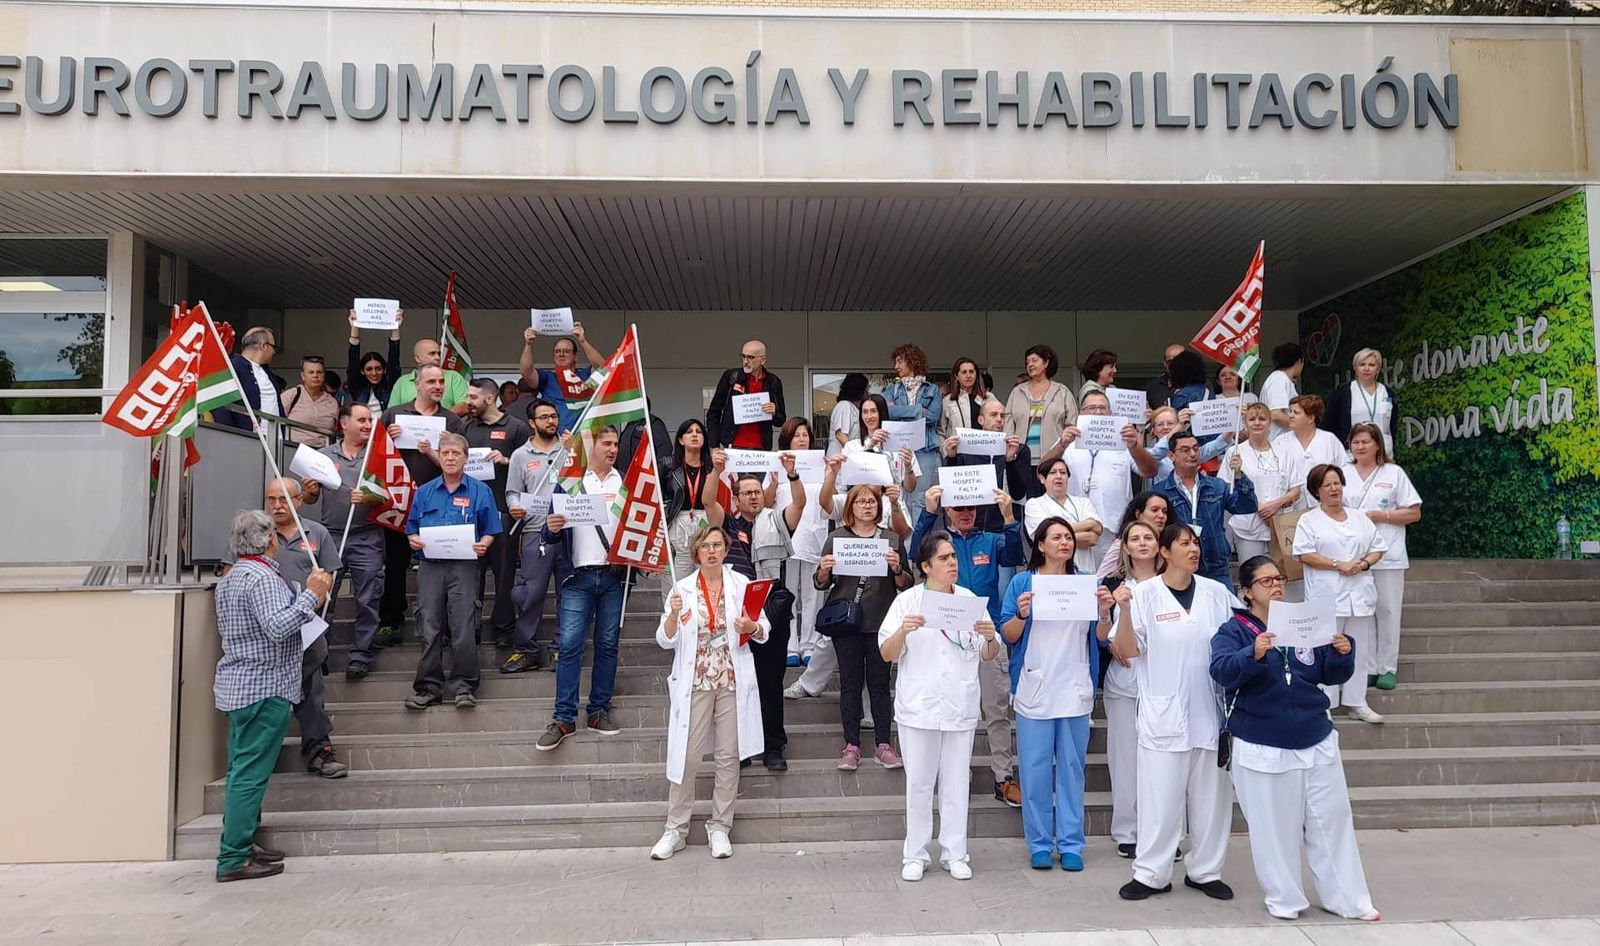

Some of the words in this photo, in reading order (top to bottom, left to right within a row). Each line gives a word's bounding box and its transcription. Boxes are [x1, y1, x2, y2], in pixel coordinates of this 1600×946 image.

[0, 49, 810, 124] EUROTRAUMATOLOGÍA
[828, 68, 869, 124] Y
[892, 56, 1459, 130] REHABILITACIÓN
[1411, 316, 1550, 383] donante
[1201, 422, 1233, 430] CELADORES
[1403, 405, 1481, 447] Dona
[1489, 378, 1574, 434] vida
